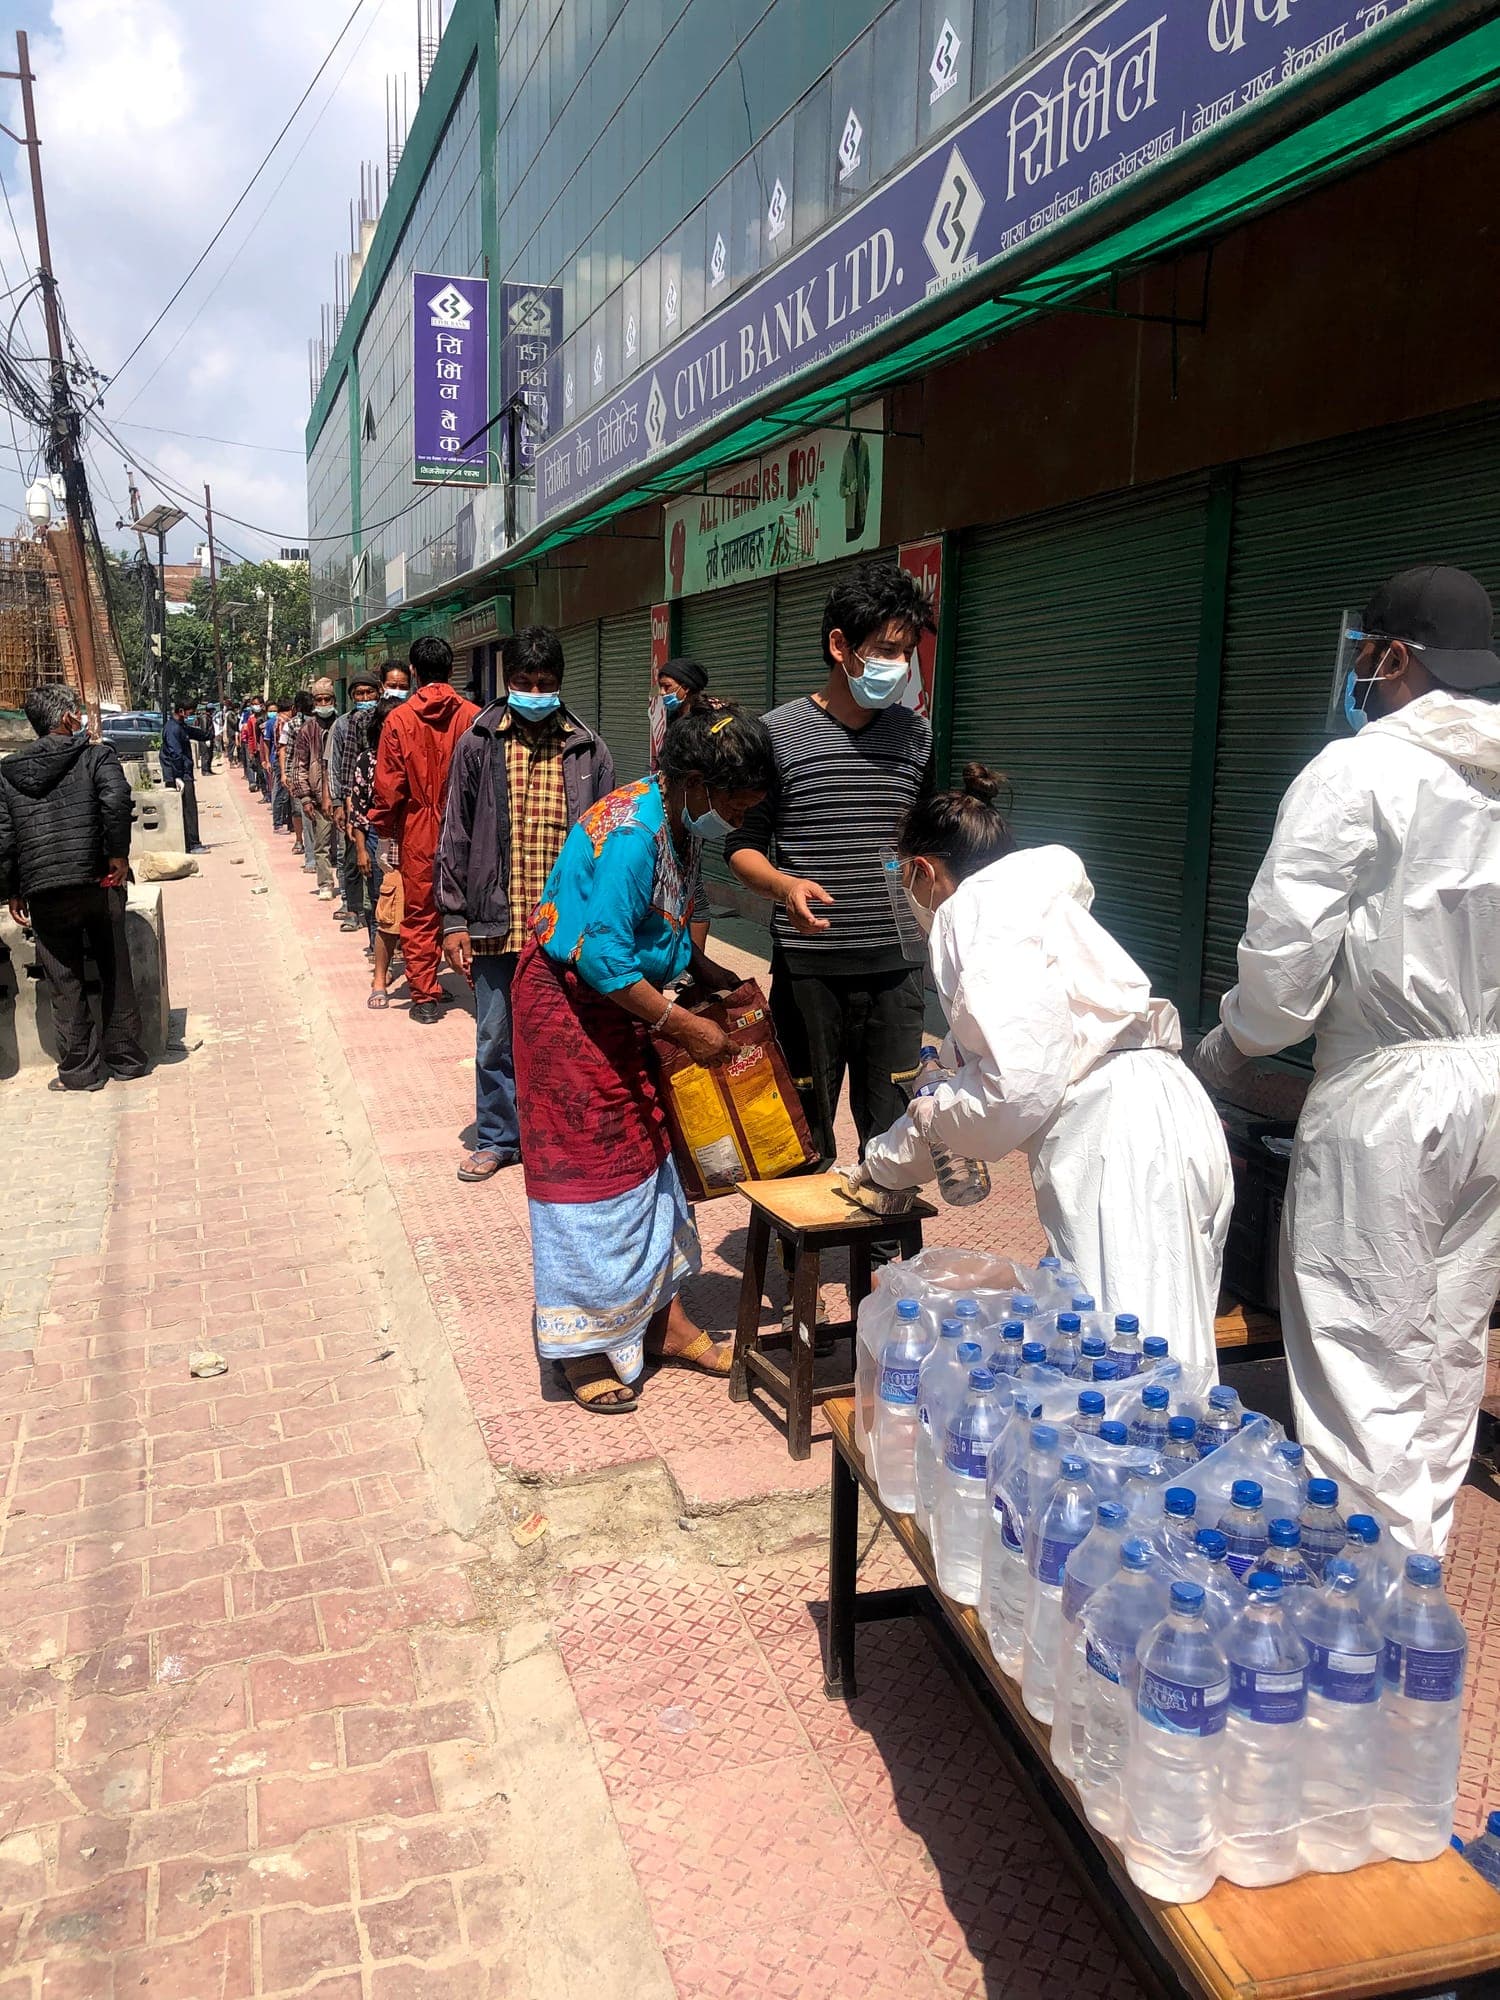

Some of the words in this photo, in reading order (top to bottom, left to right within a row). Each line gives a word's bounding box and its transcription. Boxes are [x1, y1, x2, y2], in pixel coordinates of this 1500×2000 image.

[1005, 14, 1167, 202] सिभिल
[673, 339, 734, 420] CIVIL
[739, 277, 818, 384] BANK
[825, 228, 904, 330] LTD.
[597, 400, 639, 466] लिमिटेड
[699, 496, 718, 536] ALL
[762, 462, 784, 506] RS.
[787, 441, 825, 502] 00/-
[652, 615, 668, 645] Only
